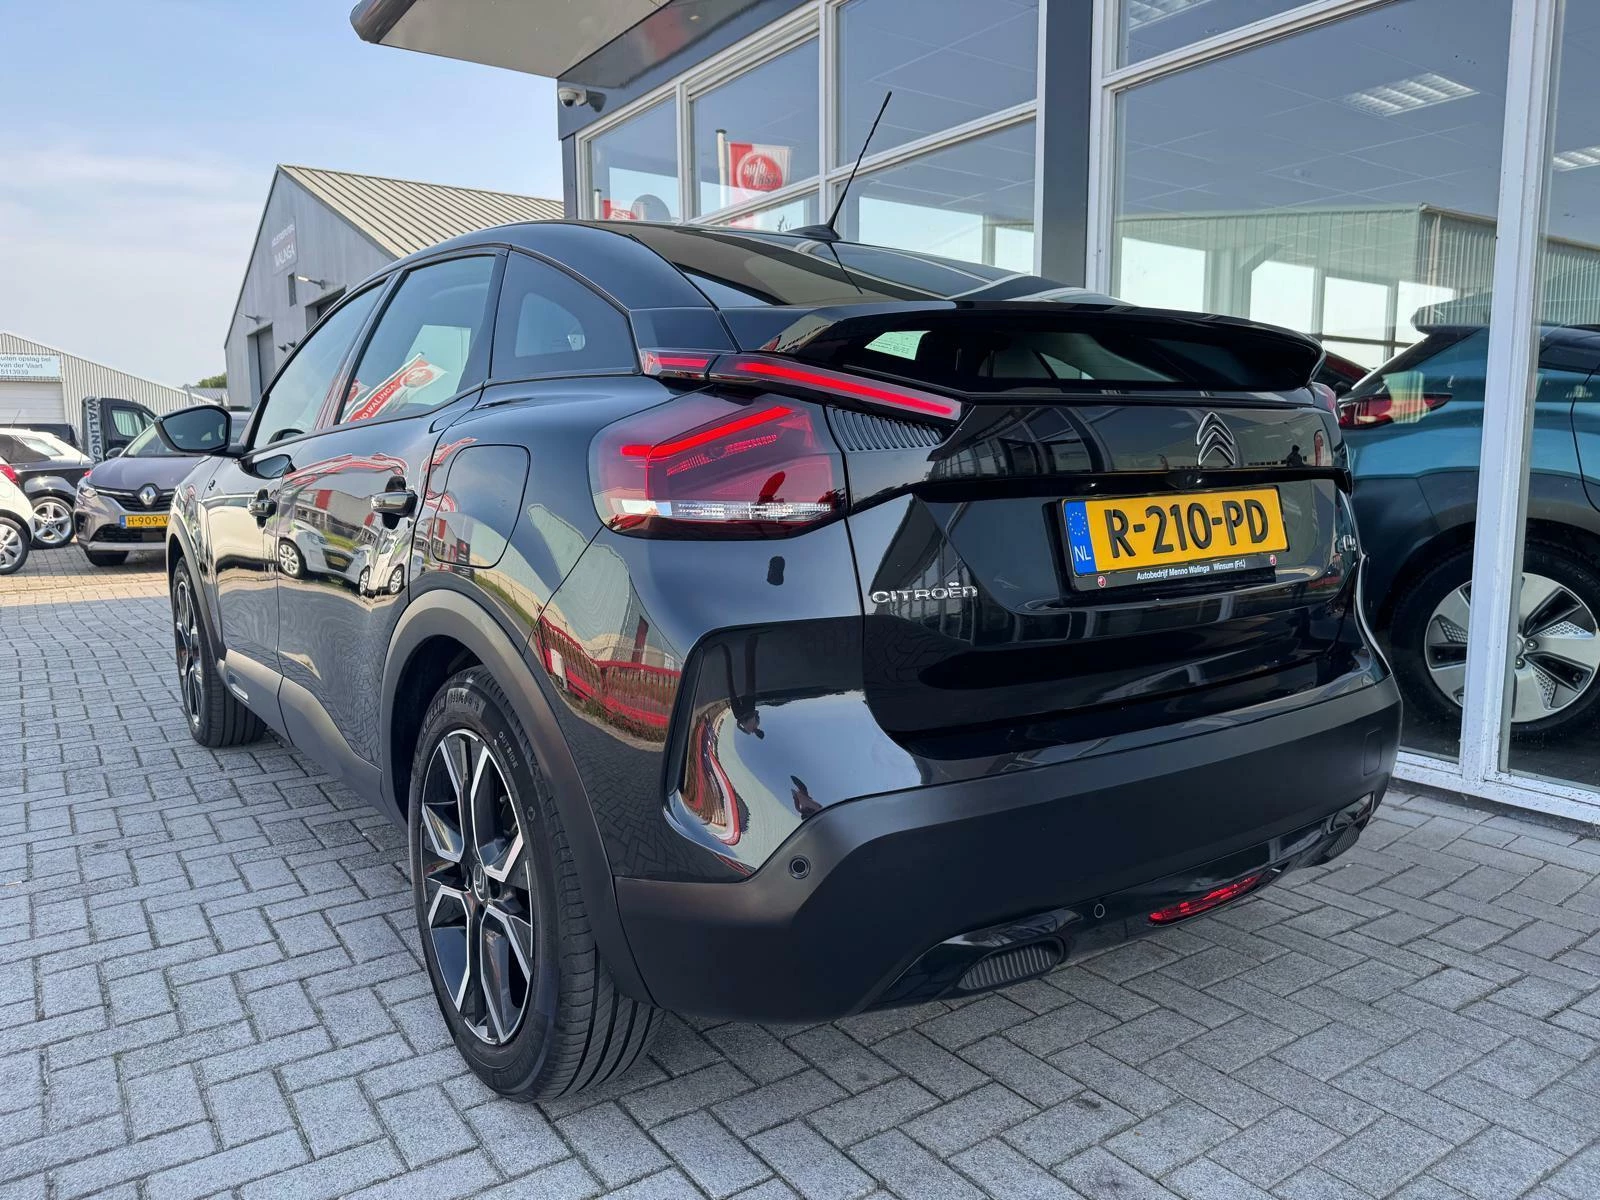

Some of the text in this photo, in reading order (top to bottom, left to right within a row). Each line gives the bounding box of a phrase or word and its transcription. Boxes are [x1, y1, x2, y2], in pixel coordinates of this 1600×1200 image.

[367, 383, 397, 413] WALINGA
[87, 398, 103, 465] WALINGA
[1075, 499, 1268, 562] NL R-210-PD
[1136, 568, 1169, 582] Autobedrijf
[1169, 567, 1189, 577] Menno
[1189, 565, 1210, 576] Walinga
[1213, 561, 1234, 571] Winsum
[498, 731, 519, 768] OUTSIDE
